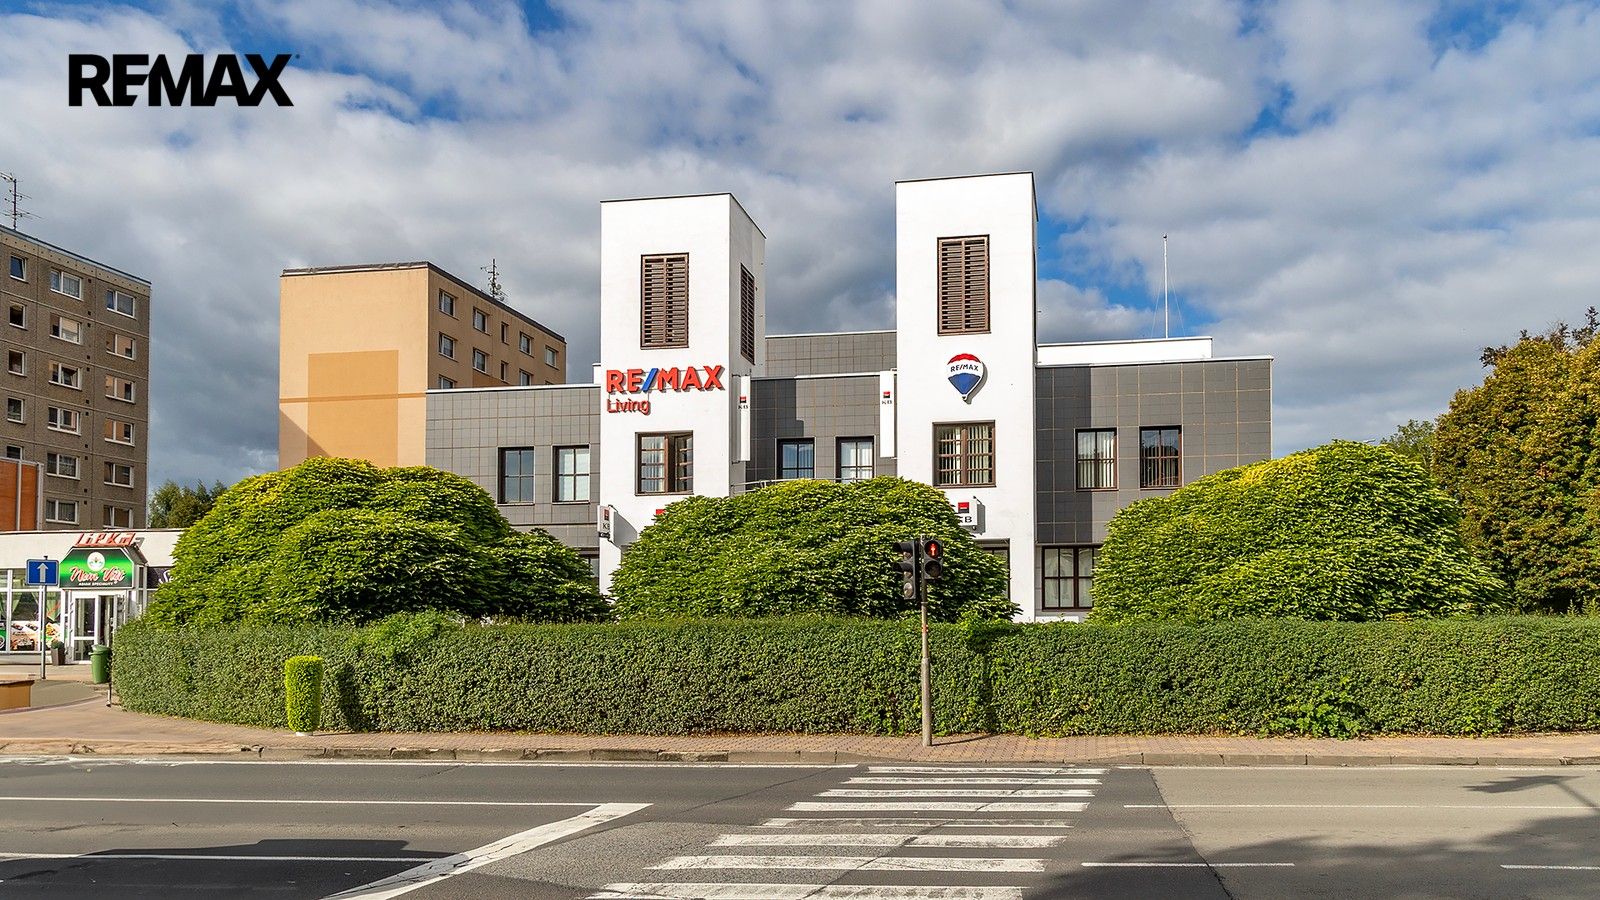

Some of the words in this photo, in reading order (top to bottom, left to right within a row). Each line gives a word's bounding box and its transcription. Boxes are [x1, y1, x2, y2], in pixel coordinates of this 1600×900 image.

[950, 364, 979, 372] RE/MAX
[606, 365, 723, 394] RE/MAX
[606, 399, 650, 416] Living
